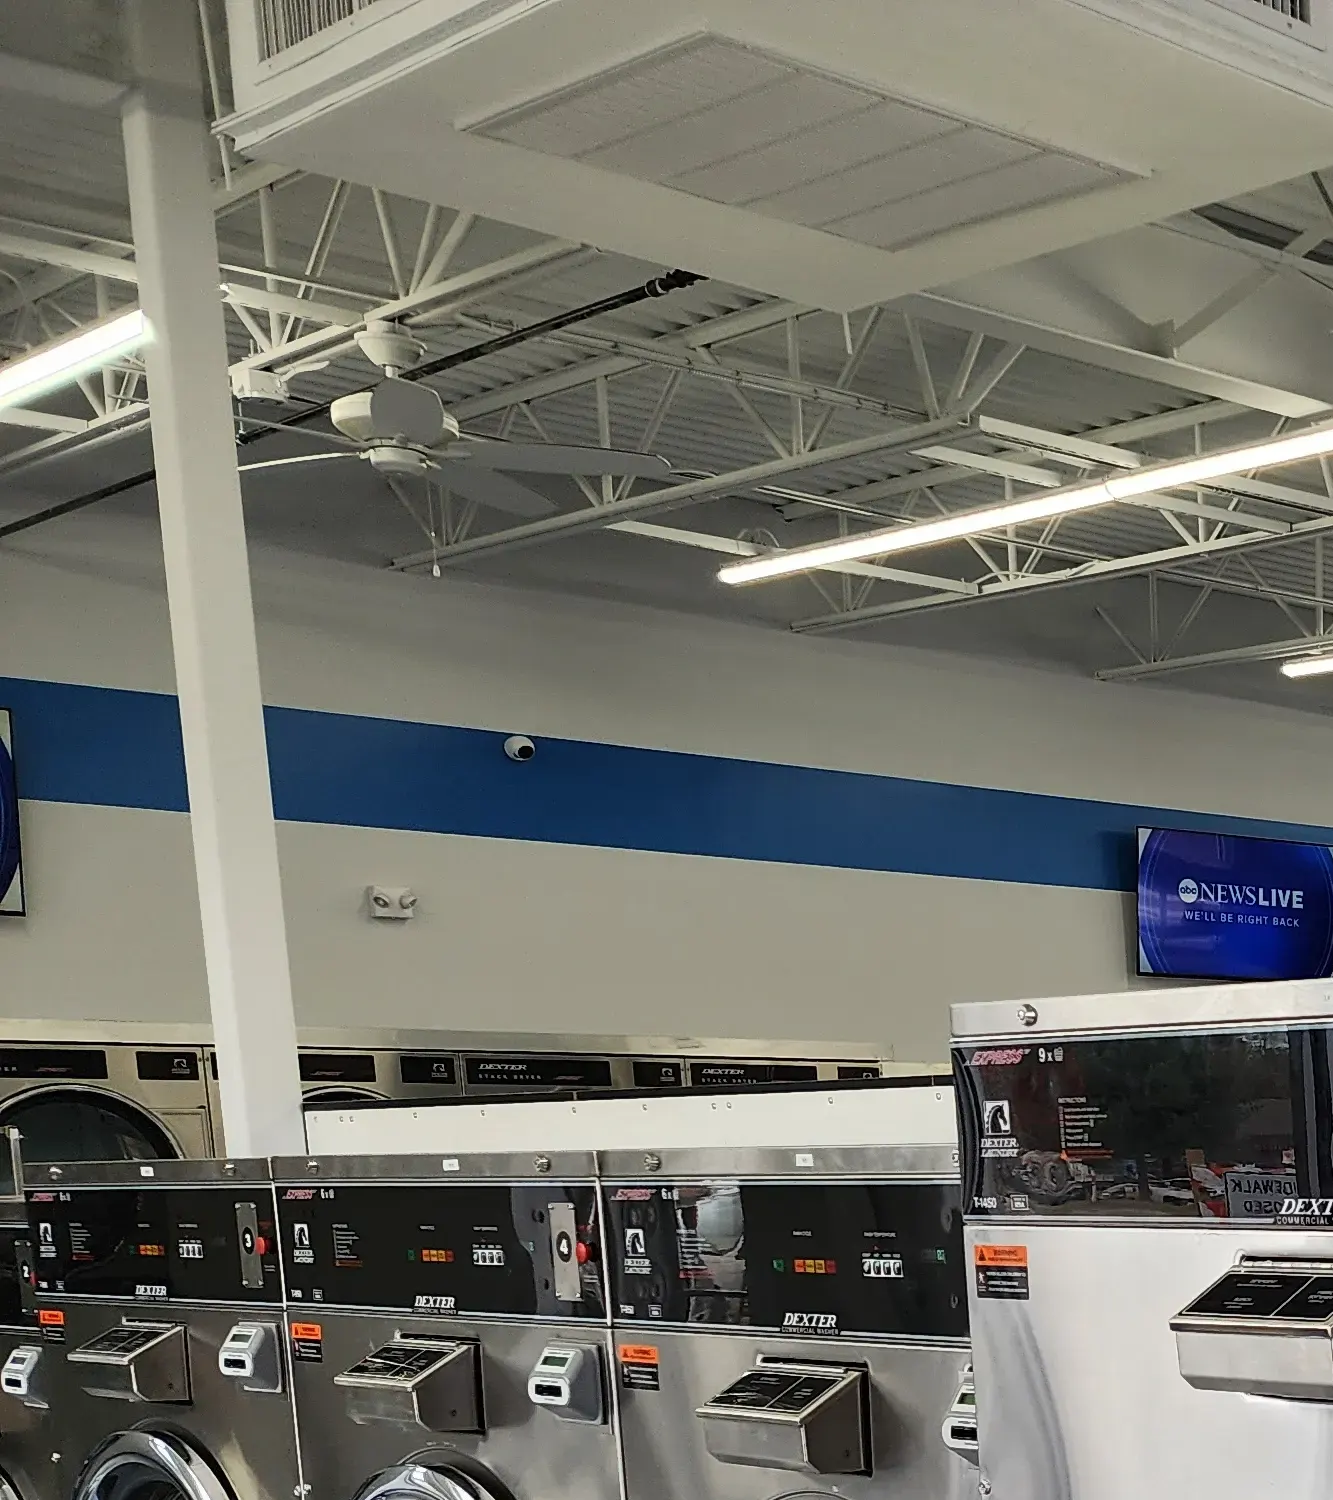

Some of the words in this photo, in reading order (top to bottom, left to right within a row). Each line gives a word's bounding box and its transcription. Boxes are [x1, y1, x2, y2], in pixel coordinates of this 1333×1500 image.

[1200, 882, 1256, 905] NEWS
[1258, 889, 1304, 909] LIVE
[1184, 910, 1216, 922] WE'LL
[1220, 913, 1234, 923] BE
[1237, 914, 1269, 925] RIGHT
[1272, 916, 1300, 928] BACK
[970, 1049, 1025, 1066] EXPRESS
[477, 1063, 528, 1071] DEXTER
[1275, 1216, 1330, 1225] COMMERCIAL
[244, 1235, 252, 1248] 3
[559, 1238, 569, 1255] 4
[22, 1265, 30, 1279] 2
[414, 1295, 456, 1308] DEXTER
[783, 1312, 837, 1327] DEXTER
